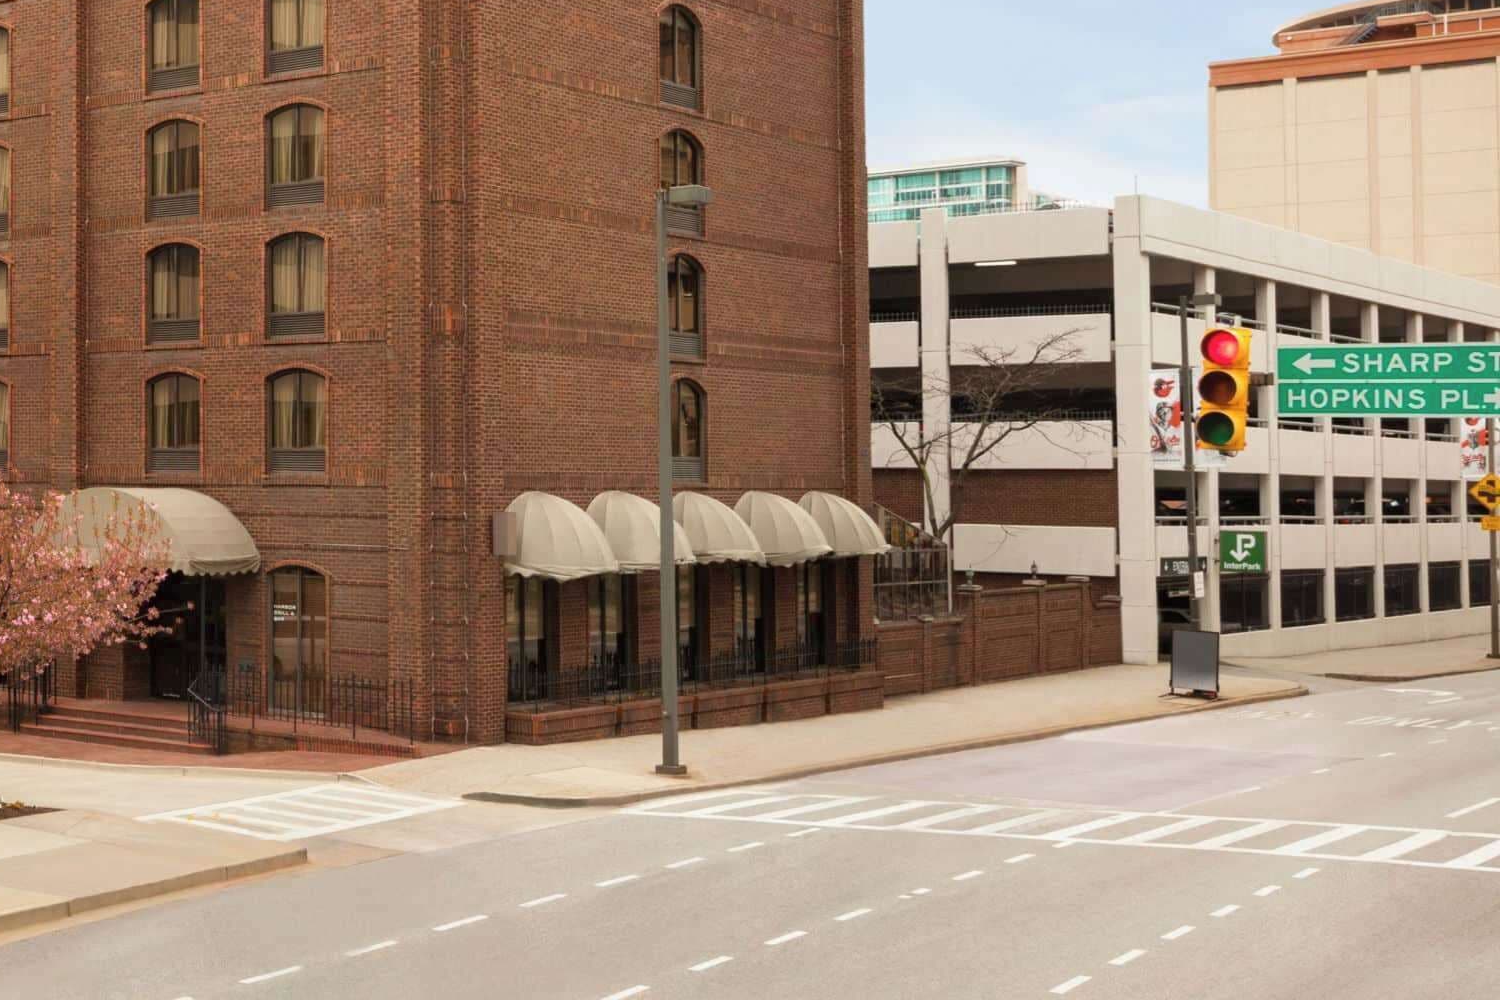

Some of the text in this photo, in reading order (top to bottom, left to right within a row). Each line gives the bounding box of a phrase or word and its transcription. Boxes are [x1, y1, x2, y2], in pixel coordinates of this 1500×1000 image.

[1342, 352, 1453, 373] SHARP
[1287, 388, 1487, 409] HOPKINS PL.
[1223, 562, 1261, 570] InterPark
